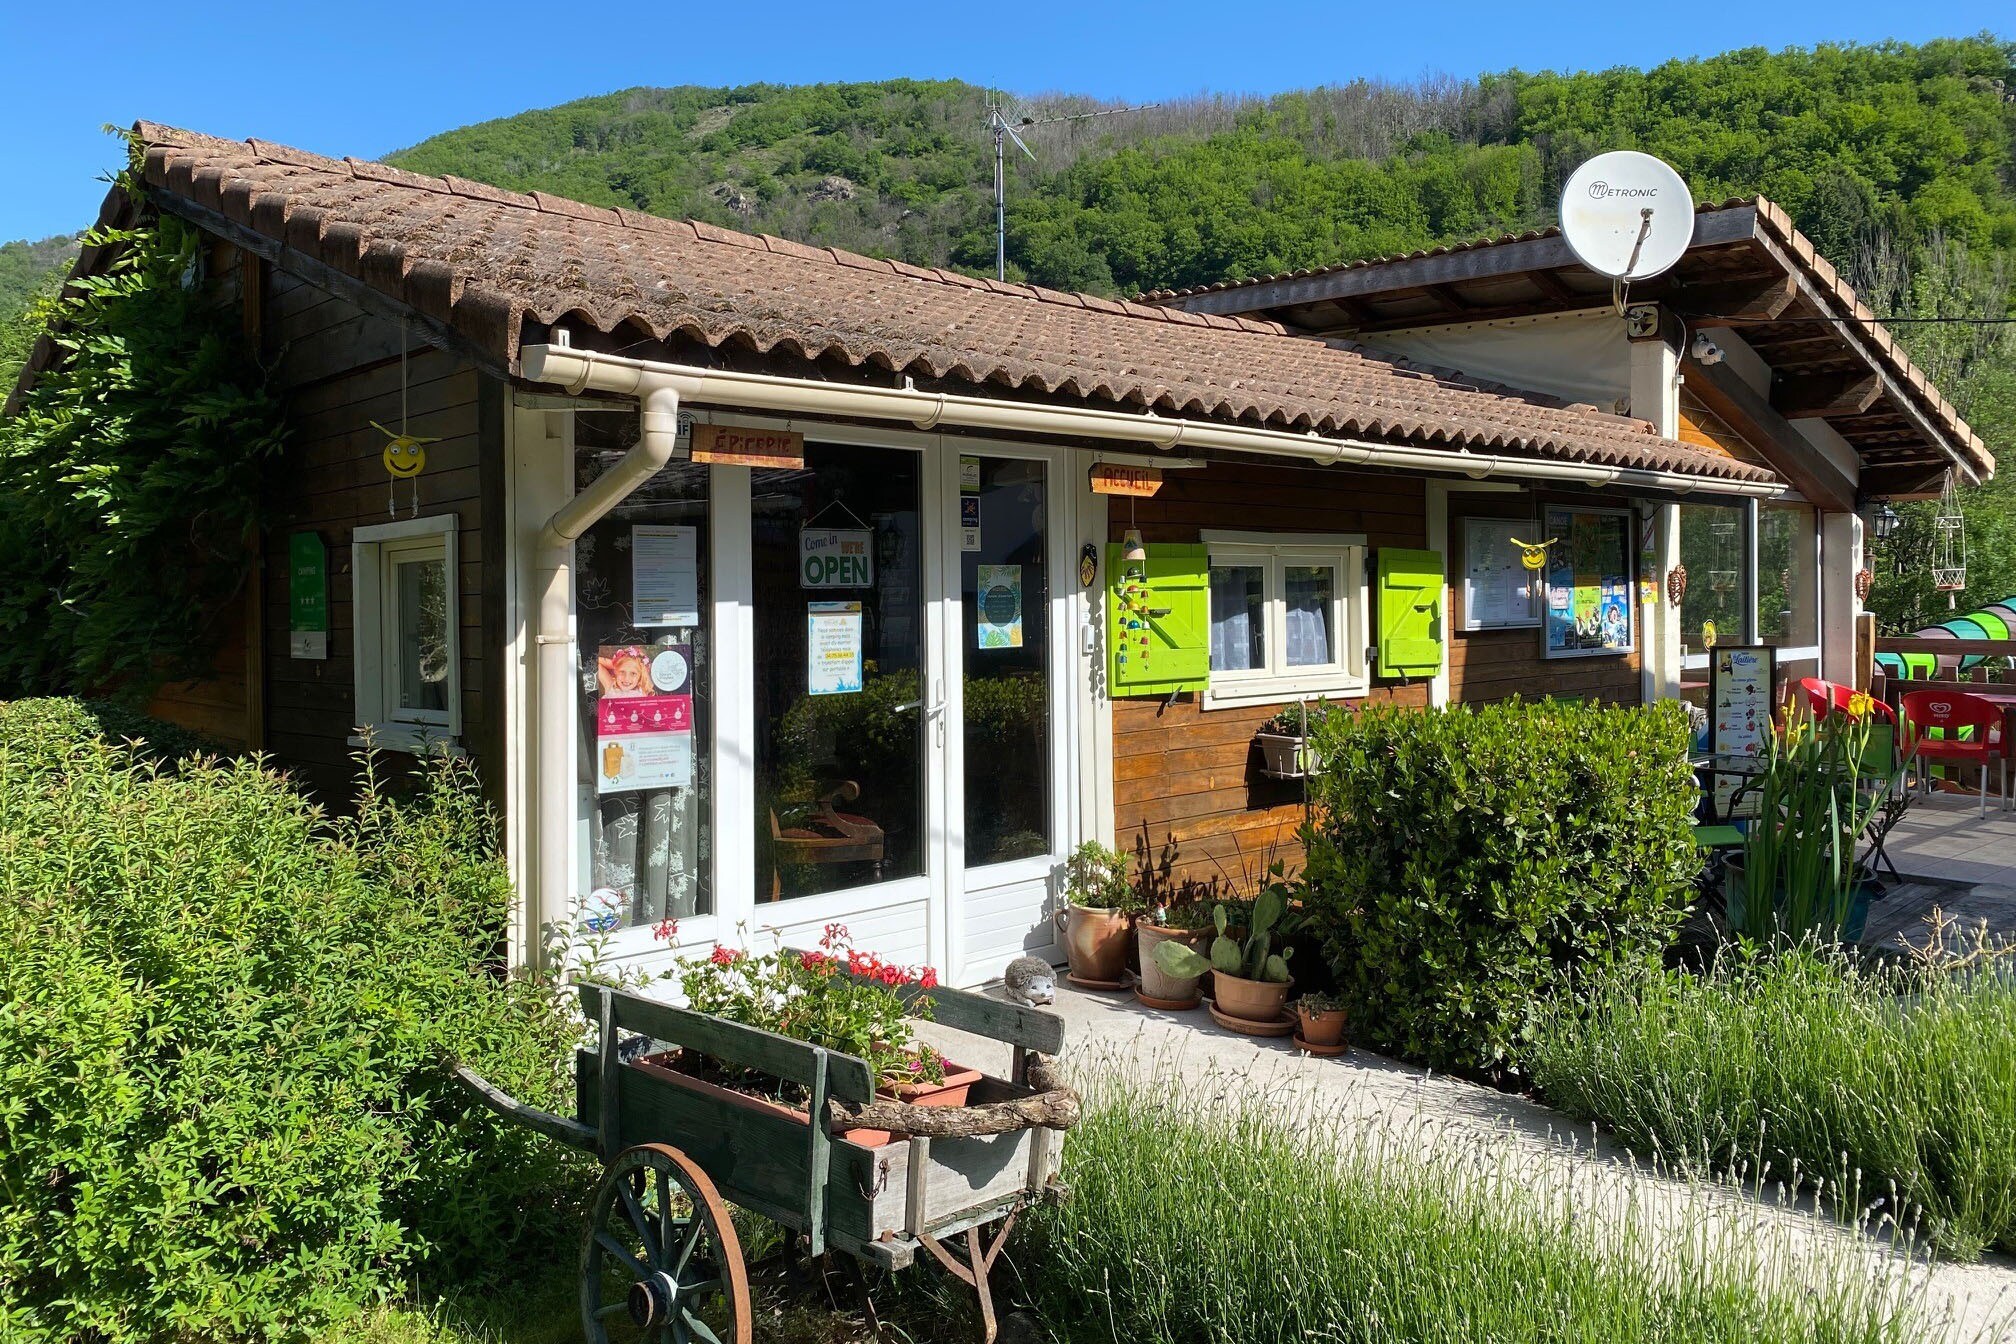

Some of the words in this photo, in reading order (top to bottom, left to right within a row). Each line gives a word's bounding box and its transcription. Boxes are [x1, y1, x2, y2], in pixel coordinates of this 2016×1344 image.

[1588, 180, 1658, 200] METRONIC
[1103, 467, 1154, 491] ACCUEIL
[805, 536, 828, 551] Come
[804, 555, 869, 585] OPEN
